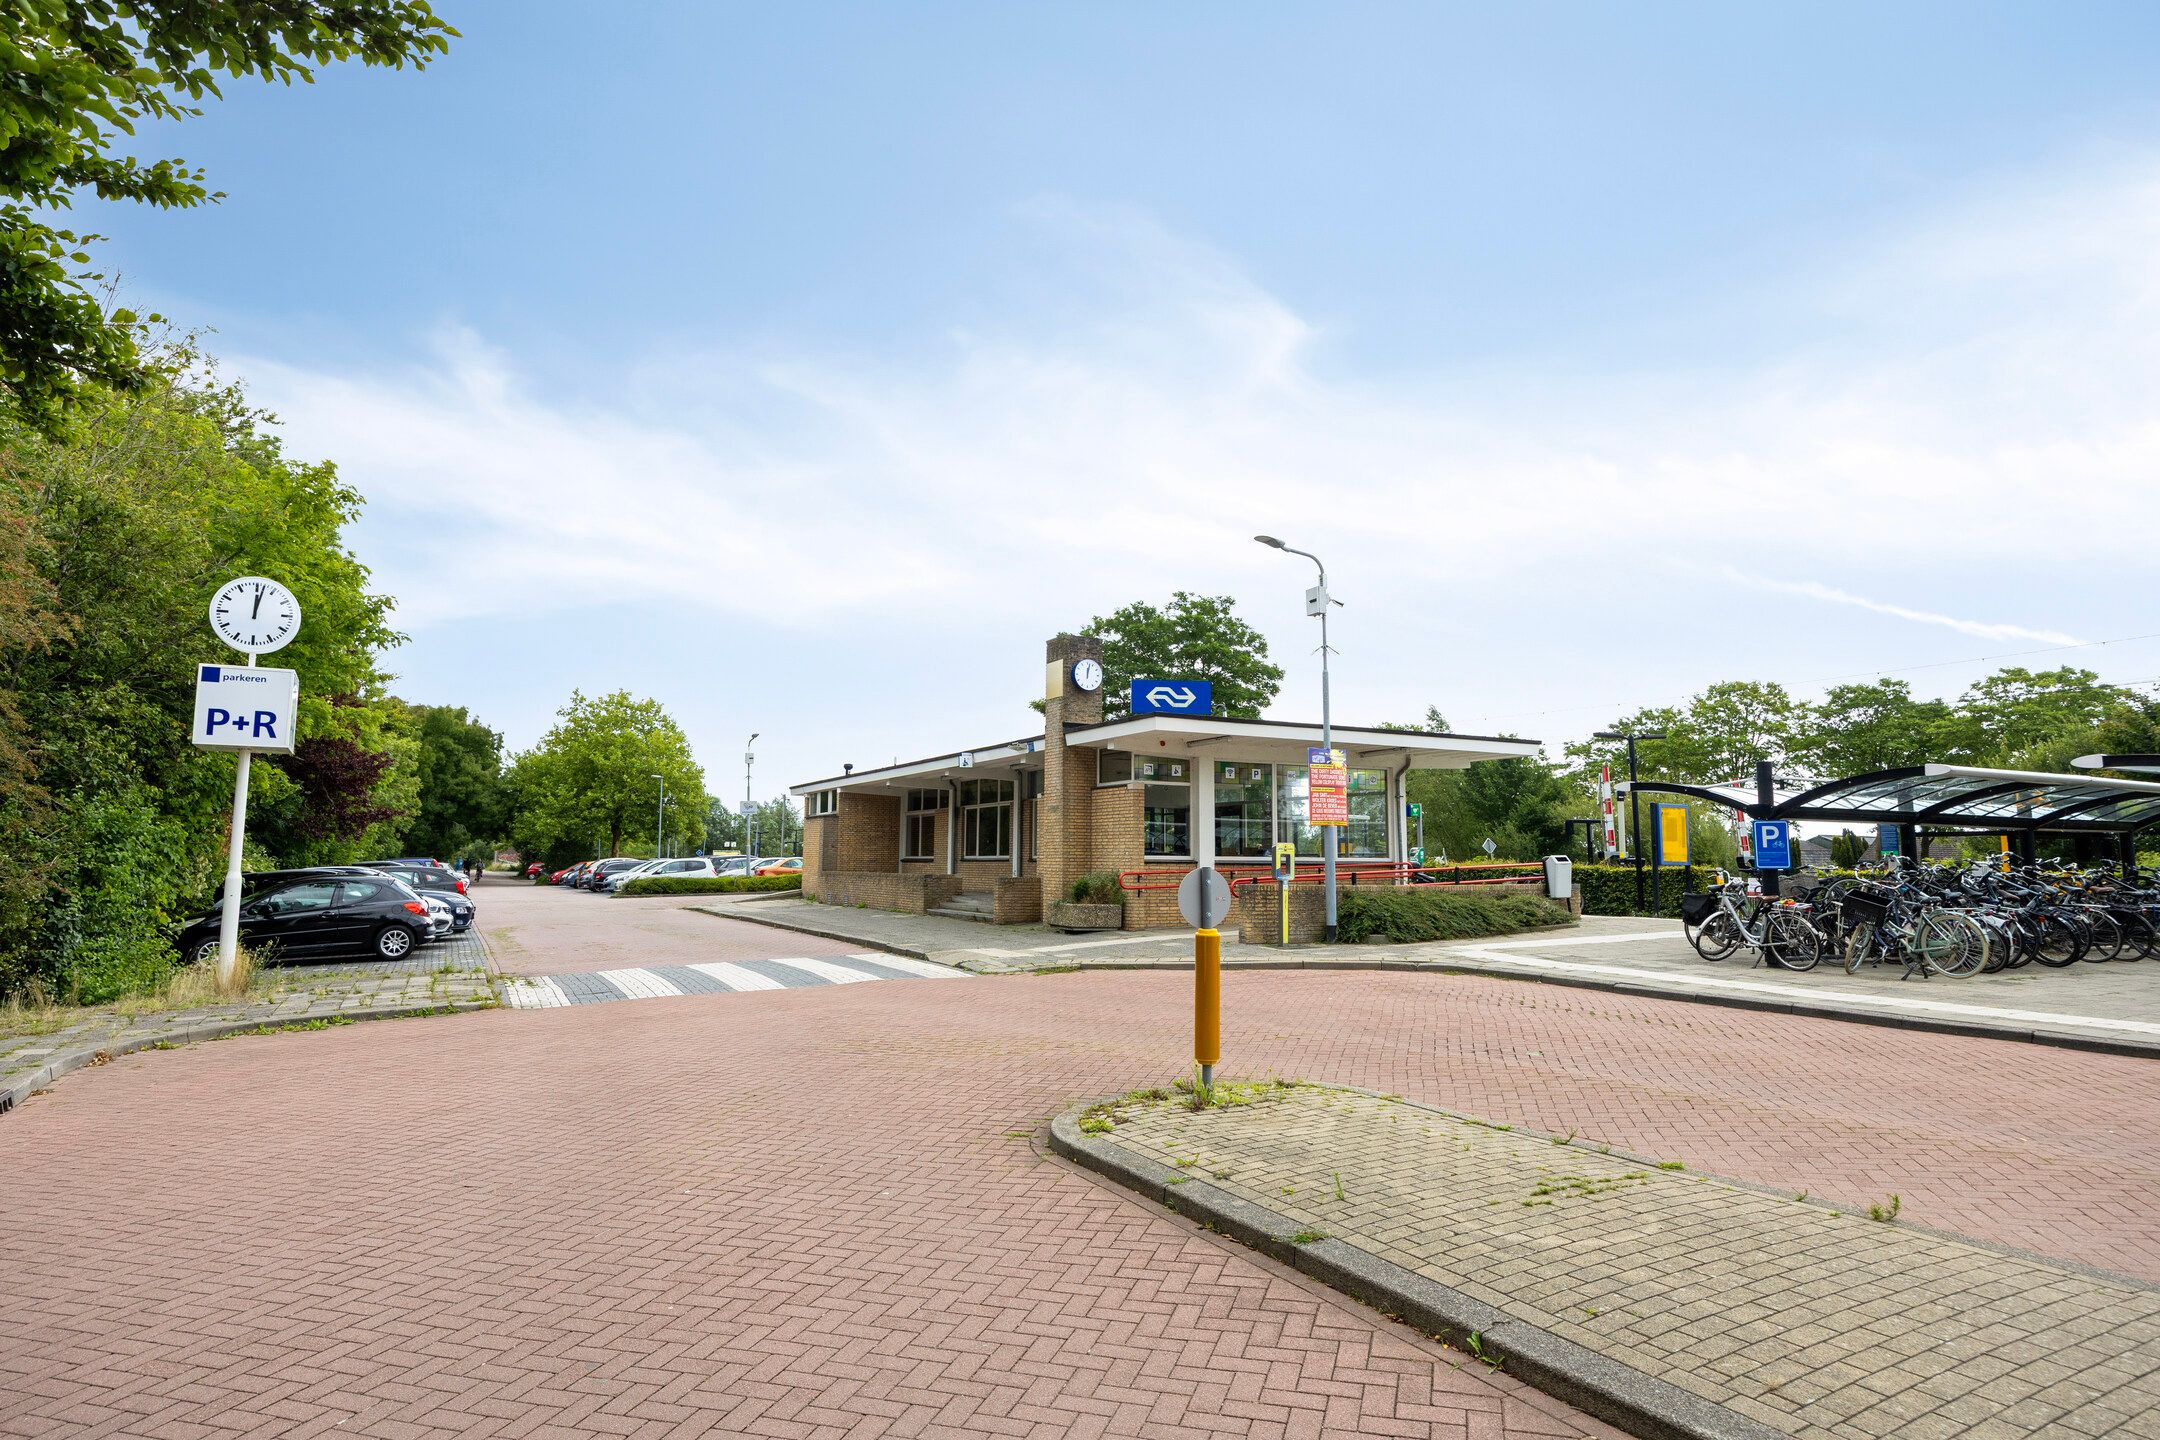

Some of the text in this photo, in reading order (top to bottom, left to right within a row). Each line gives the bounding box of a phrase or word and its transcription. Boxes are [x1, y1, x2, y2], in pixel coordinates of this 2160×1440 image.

[223, 674, 267, 683] parkeren
[206, 708, 277, 739] P+R
[1762, 826, 1779, 848] P
